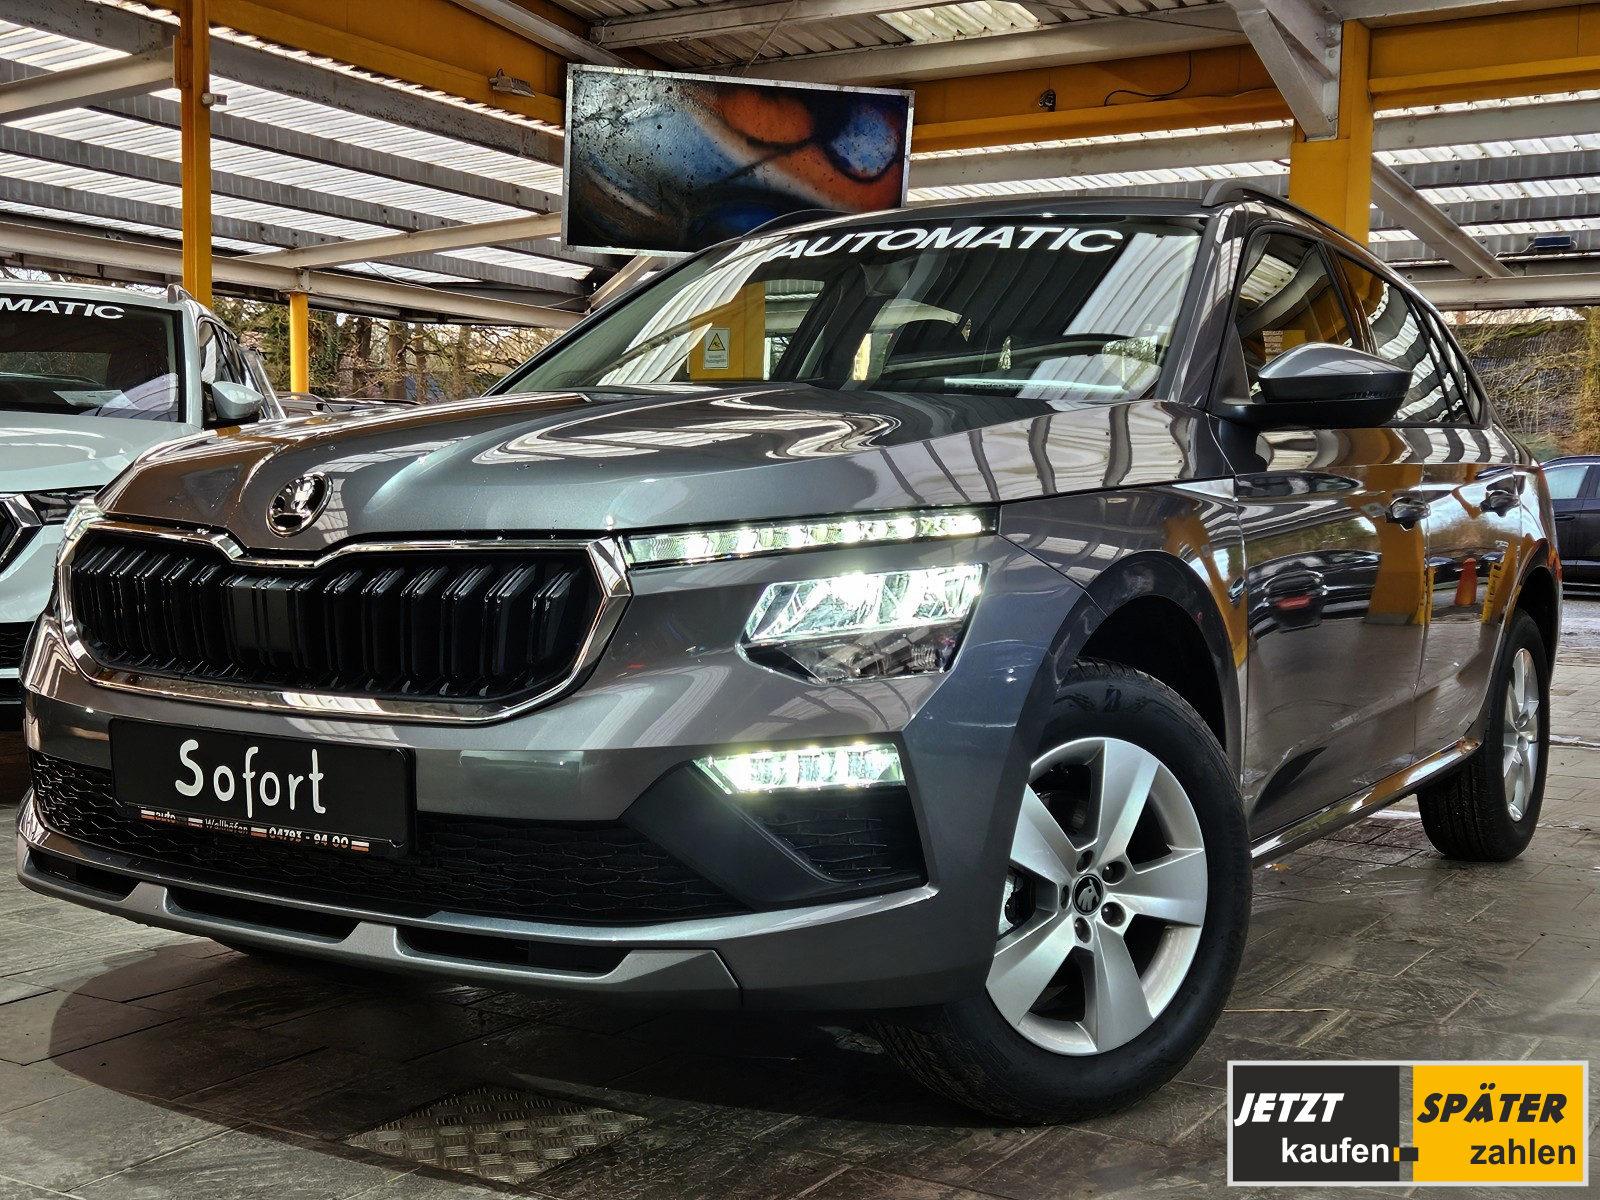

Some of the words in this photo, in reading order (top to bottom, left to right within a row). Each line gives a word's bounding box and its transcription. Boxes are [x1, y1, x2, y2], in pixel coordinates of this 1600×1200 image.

[767, 226, 1124, 260] AUTOMATIC
[174, 738, 327, 819] Sofort
[268, 826, 303, 842] 04793
[313, 832, 329, 846] 94
[331, 835, 349, 849] 00
